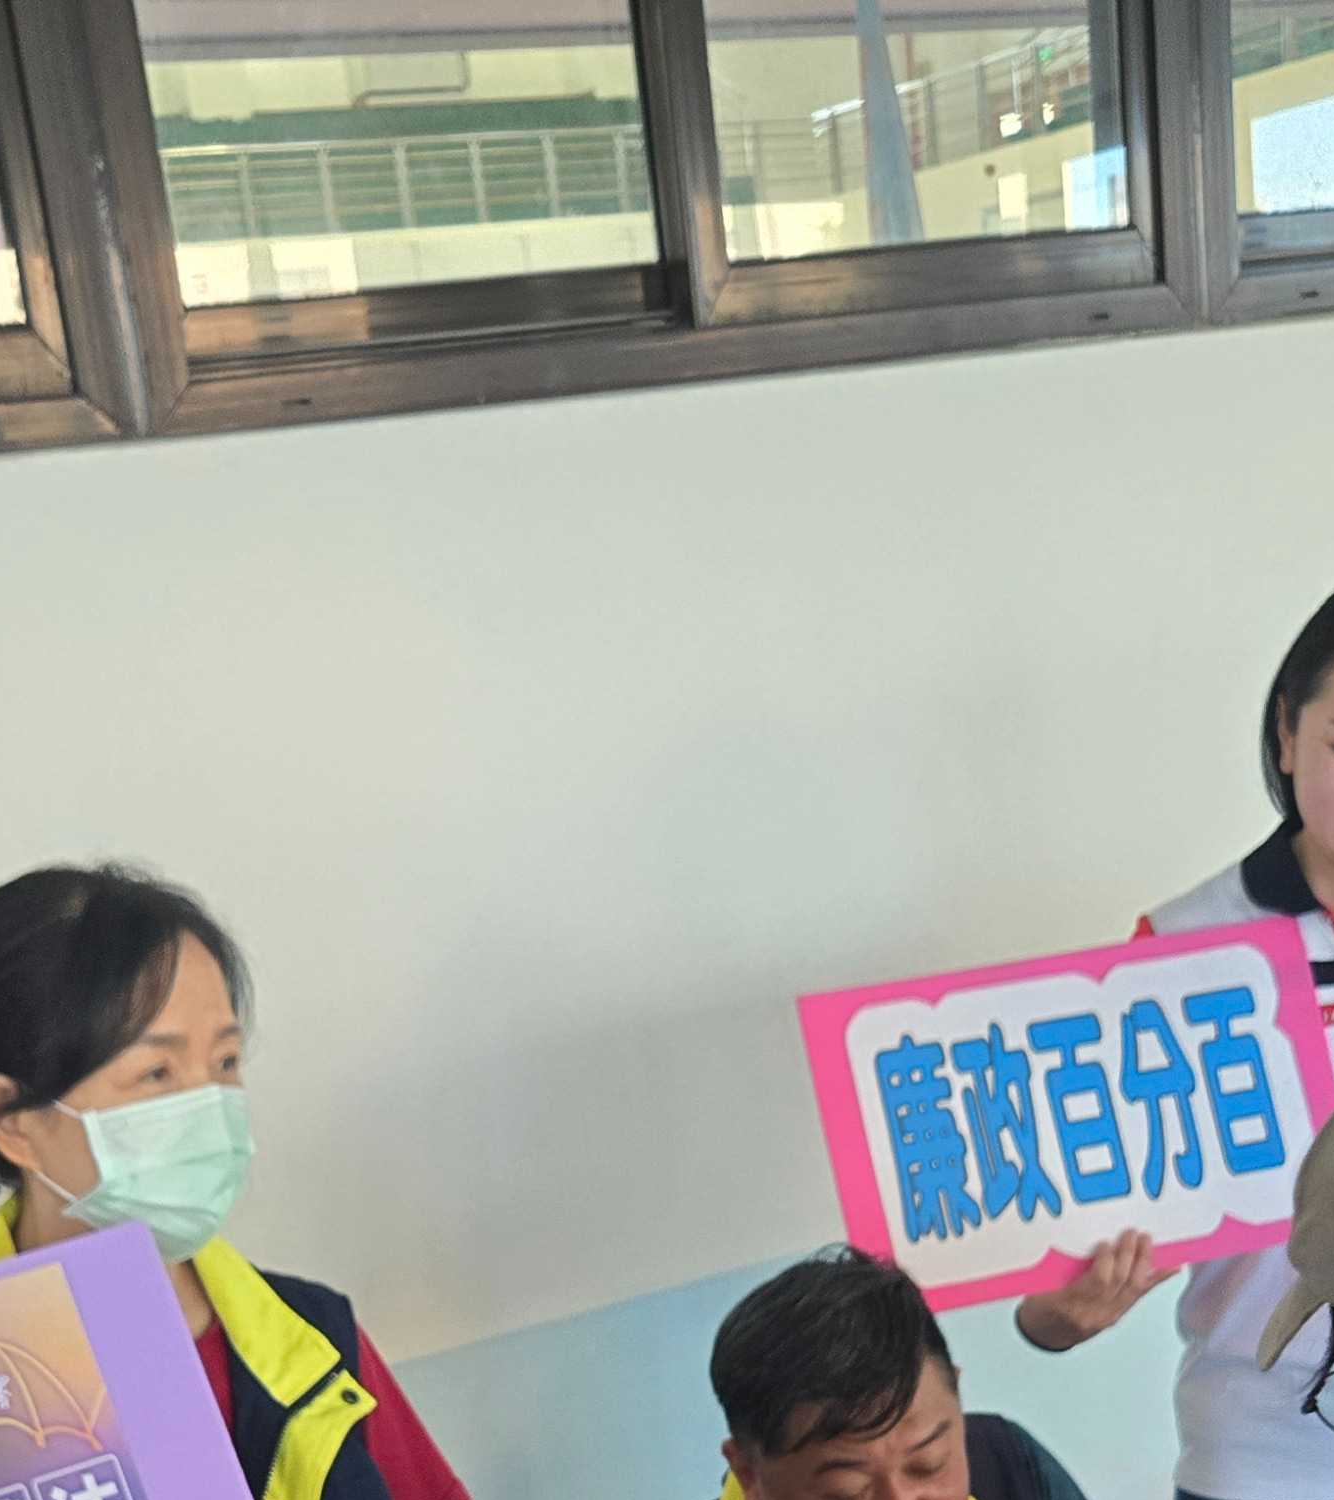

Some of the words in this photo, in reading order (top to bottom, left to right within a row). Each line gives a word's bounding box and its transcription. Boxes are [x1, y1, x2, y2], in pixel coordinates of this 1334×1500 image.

[873, 985, 1287, 1243] 廉政百分百
